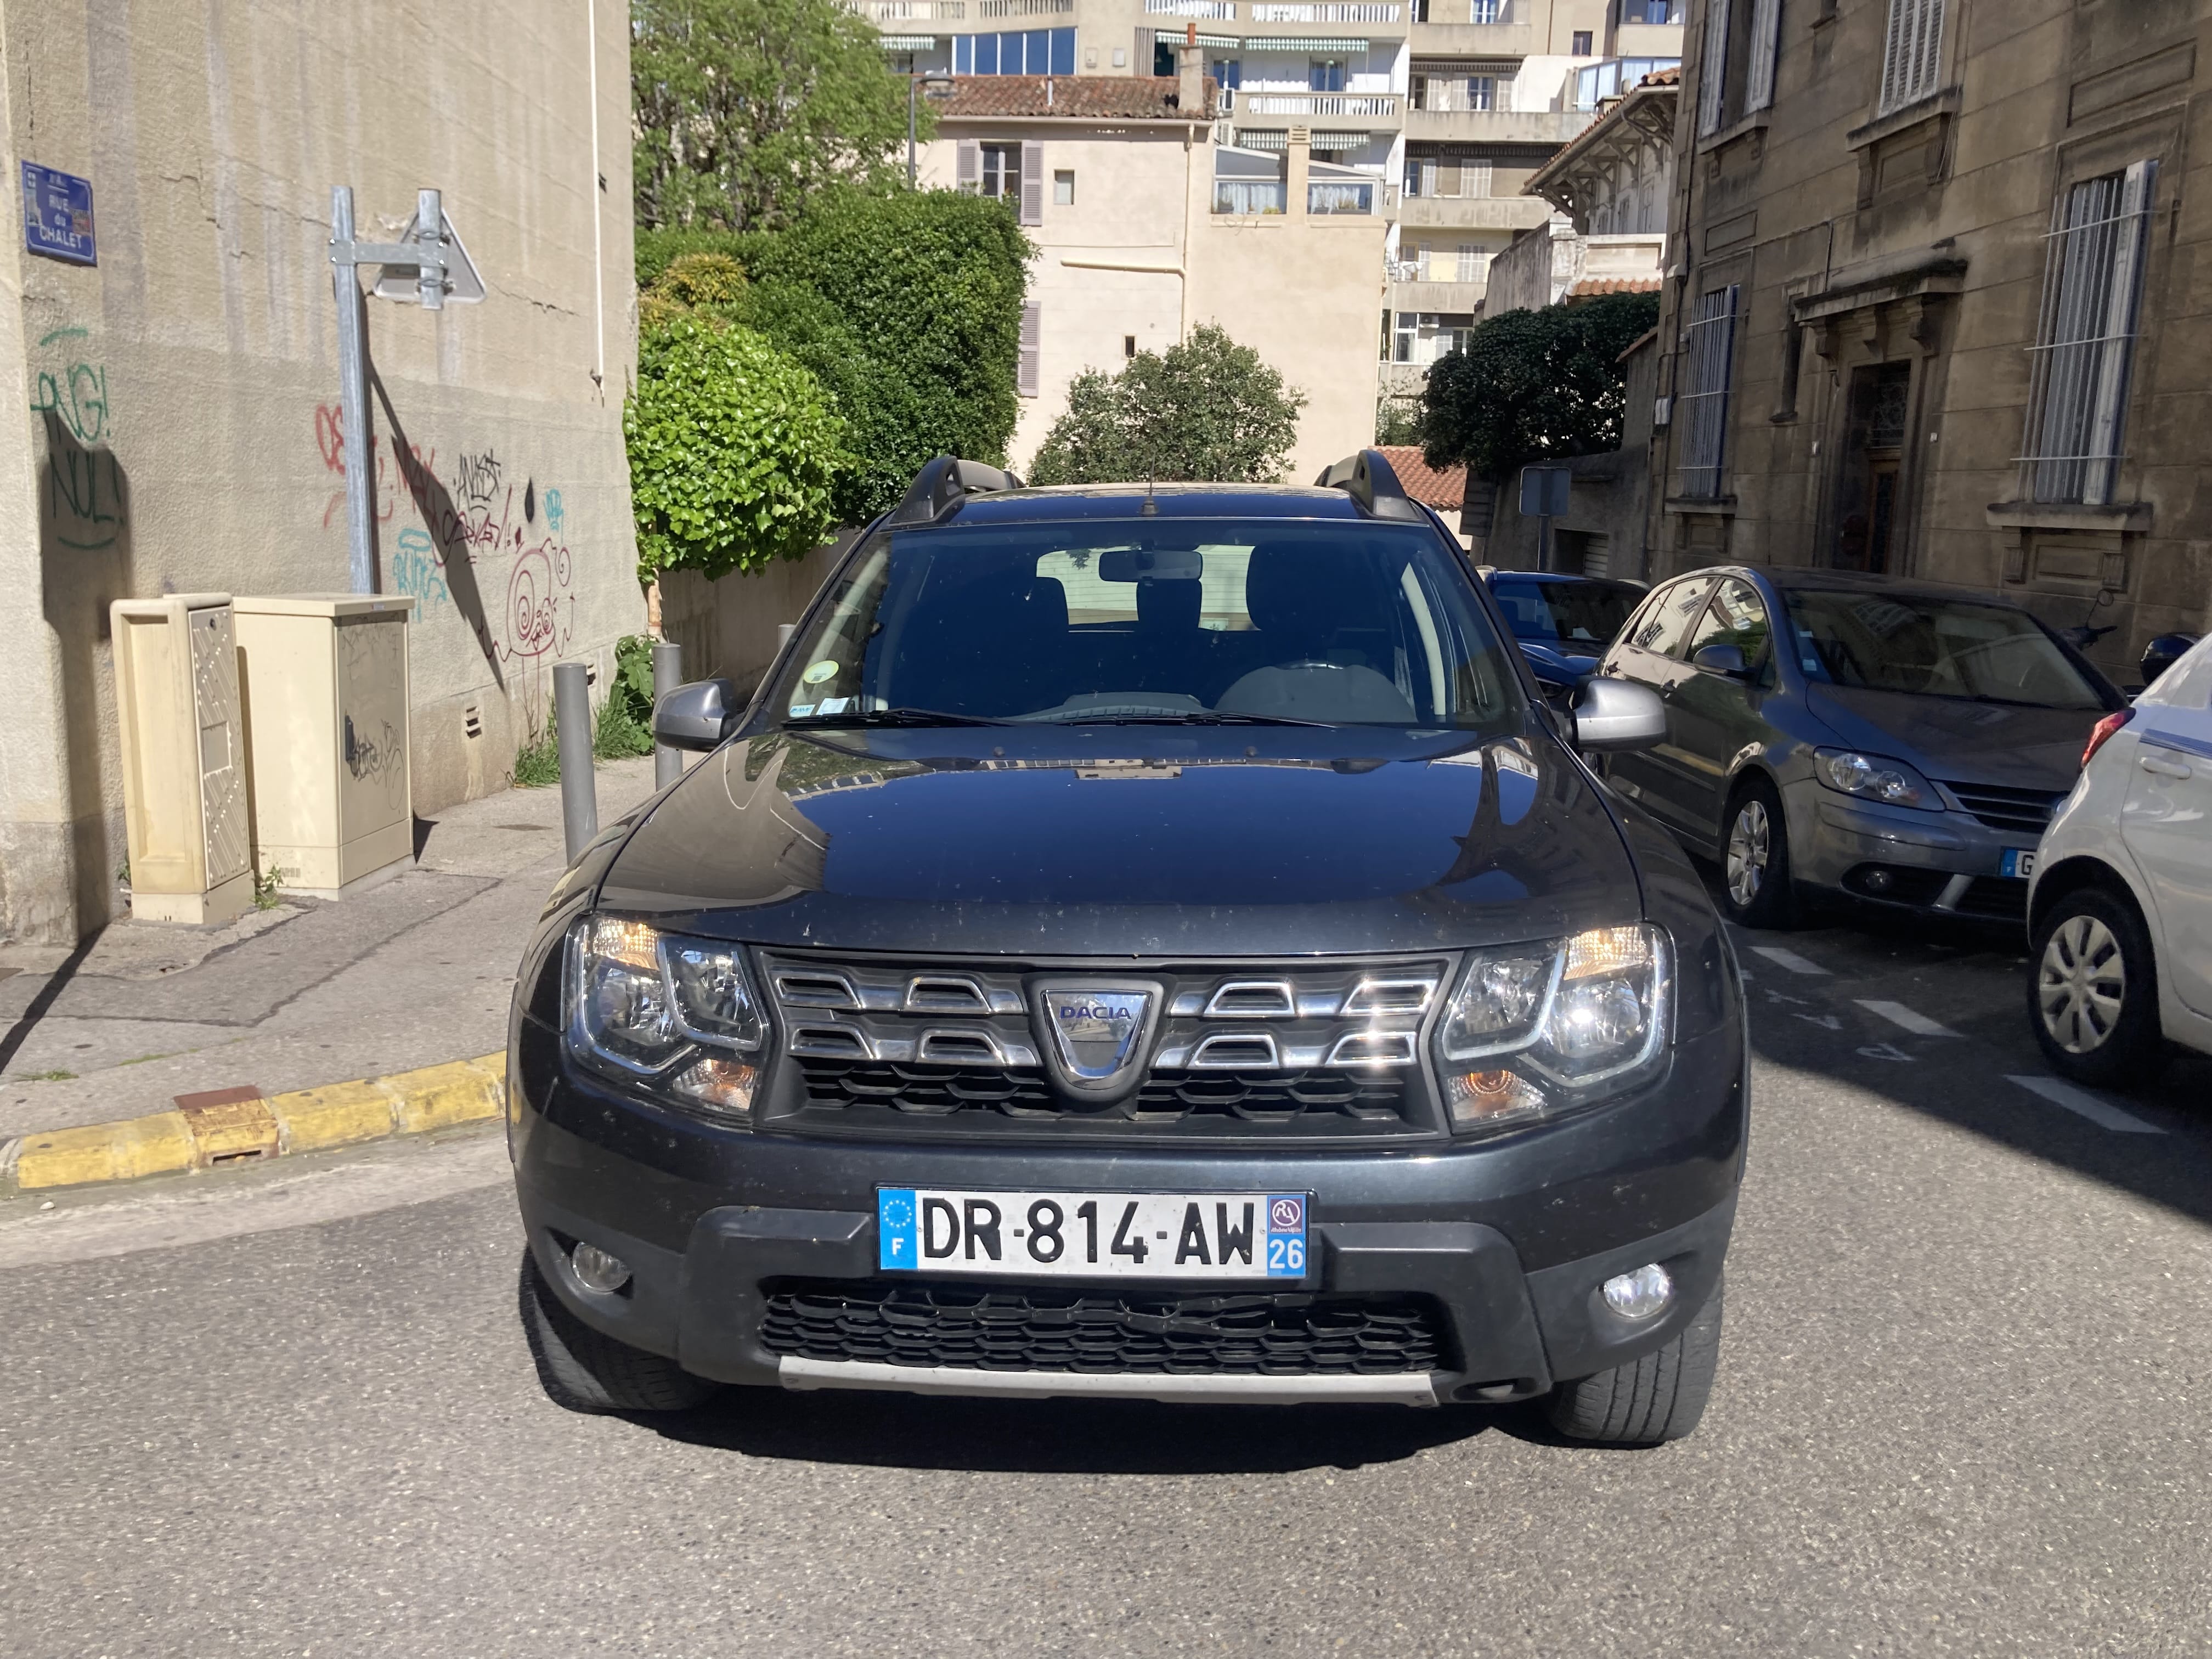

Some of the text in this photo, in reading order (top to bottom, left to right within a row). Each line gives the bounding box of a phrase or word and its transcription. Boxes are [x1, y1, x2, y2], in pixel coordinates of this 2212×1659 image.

[48, 194, 69, 212] RUE
[54, 213, 66, 227] du
[39, 225, 82, 249] CHALET
[1060, 1006, 1132, 1020] DACIA
[923, 1197, 1255, 1265] DR-814-AW
[891, 1238, 904, 1255] F
[1269, 1238, 1304, 1269] 26
